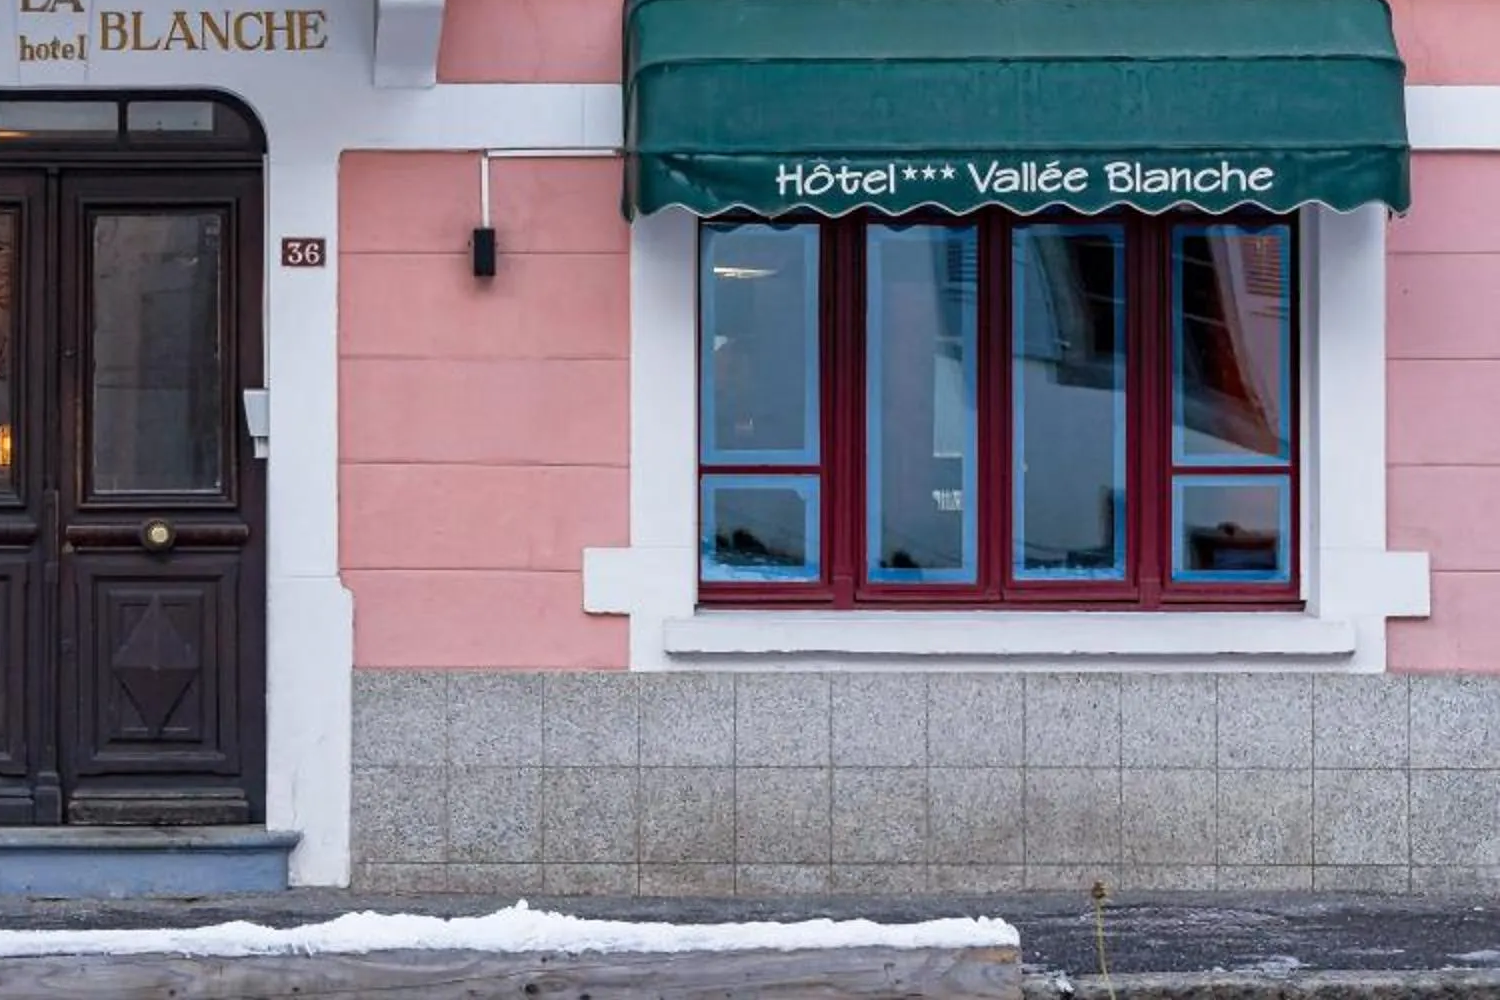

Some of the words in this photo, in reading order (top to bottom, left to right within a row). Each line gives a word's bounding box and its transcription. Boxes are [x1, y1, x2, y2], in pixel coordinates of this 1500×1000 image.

[99, 9, 327, 53] BLANCHE
[19, 34, 88, 62] hotel
[775, 160, 895, 196] Hôtel
[967, 161, 1089, 193] Vallée
[1104, 161, 1274, 193] Blanche
[287, 242, 320, 264] 36
